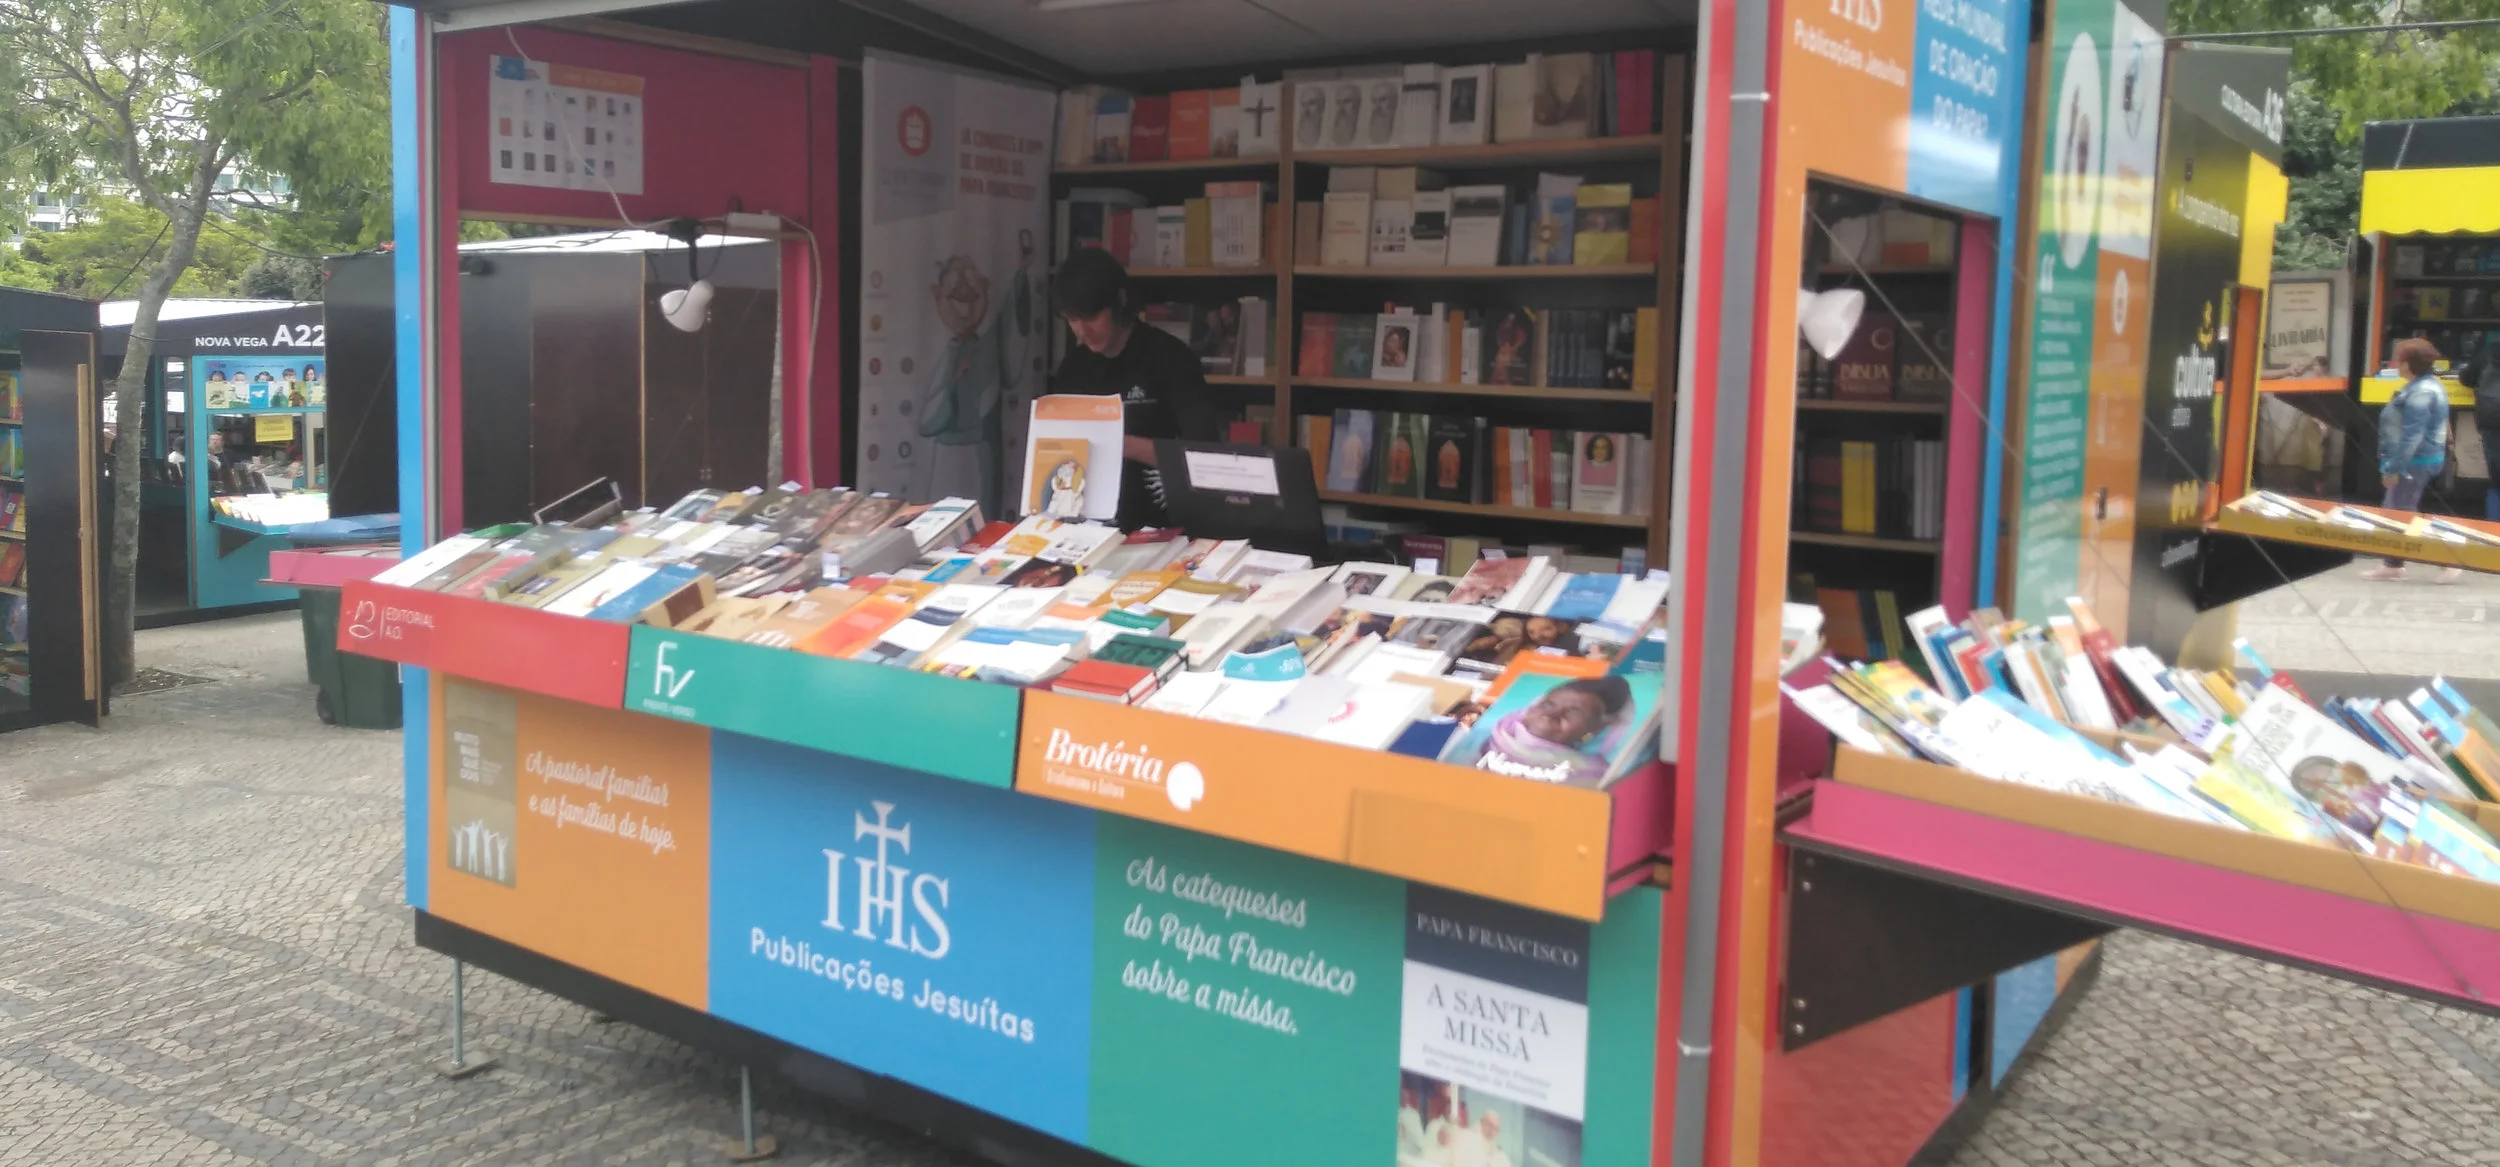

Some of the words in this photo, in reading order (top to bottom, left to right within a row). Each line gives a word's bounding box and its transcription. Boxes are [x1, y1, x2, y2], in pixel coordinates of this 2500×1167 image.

[195, 337, 232, 347] NOVA
[234, 337, 268, 347] VEGA
[272, 324, 325, 347] A22
[2174, 343, 2216, 397] cultura
[386, 607, 436, 629] EDITORIAL
[525, 750, 543, 775] A
[543, 757, 609, 791] pastoral
[605, 766, 670, 808] familiar
[1044, 727, 1164, 784] Brotéria
[529, 794, 539, 812] e
[540, 798, 556, 817] as
[618, 812, 638, 839] de
[820, 847, 950, 960] IHS
[1126, 856, 1167, 894] As
[1172, 872, 1309, 930] catequeses
[1124, 903, 1151, 941] do
[1160, 912, 1222, 963] Papa
[1228, 930, 1357, 997] Francisco
[1416, 911, 1464, 942] PAPA
[1468, 924, 1581, 969] FRANCISCO
[750, 926, 905, 1001] Publicações
[913, 979, 1035, 1044] Jesuítas
[1122, 959, 1191, 1005] sobre
[1194, 983, 1211, 1011] a
[1215, 986, 1298, 1037] missa.
[1426, 982, 1446, 1009] A
[1453, 989, 1551, 1037] SANTA
[1444, 1015, 1532, 1063] MISSA
